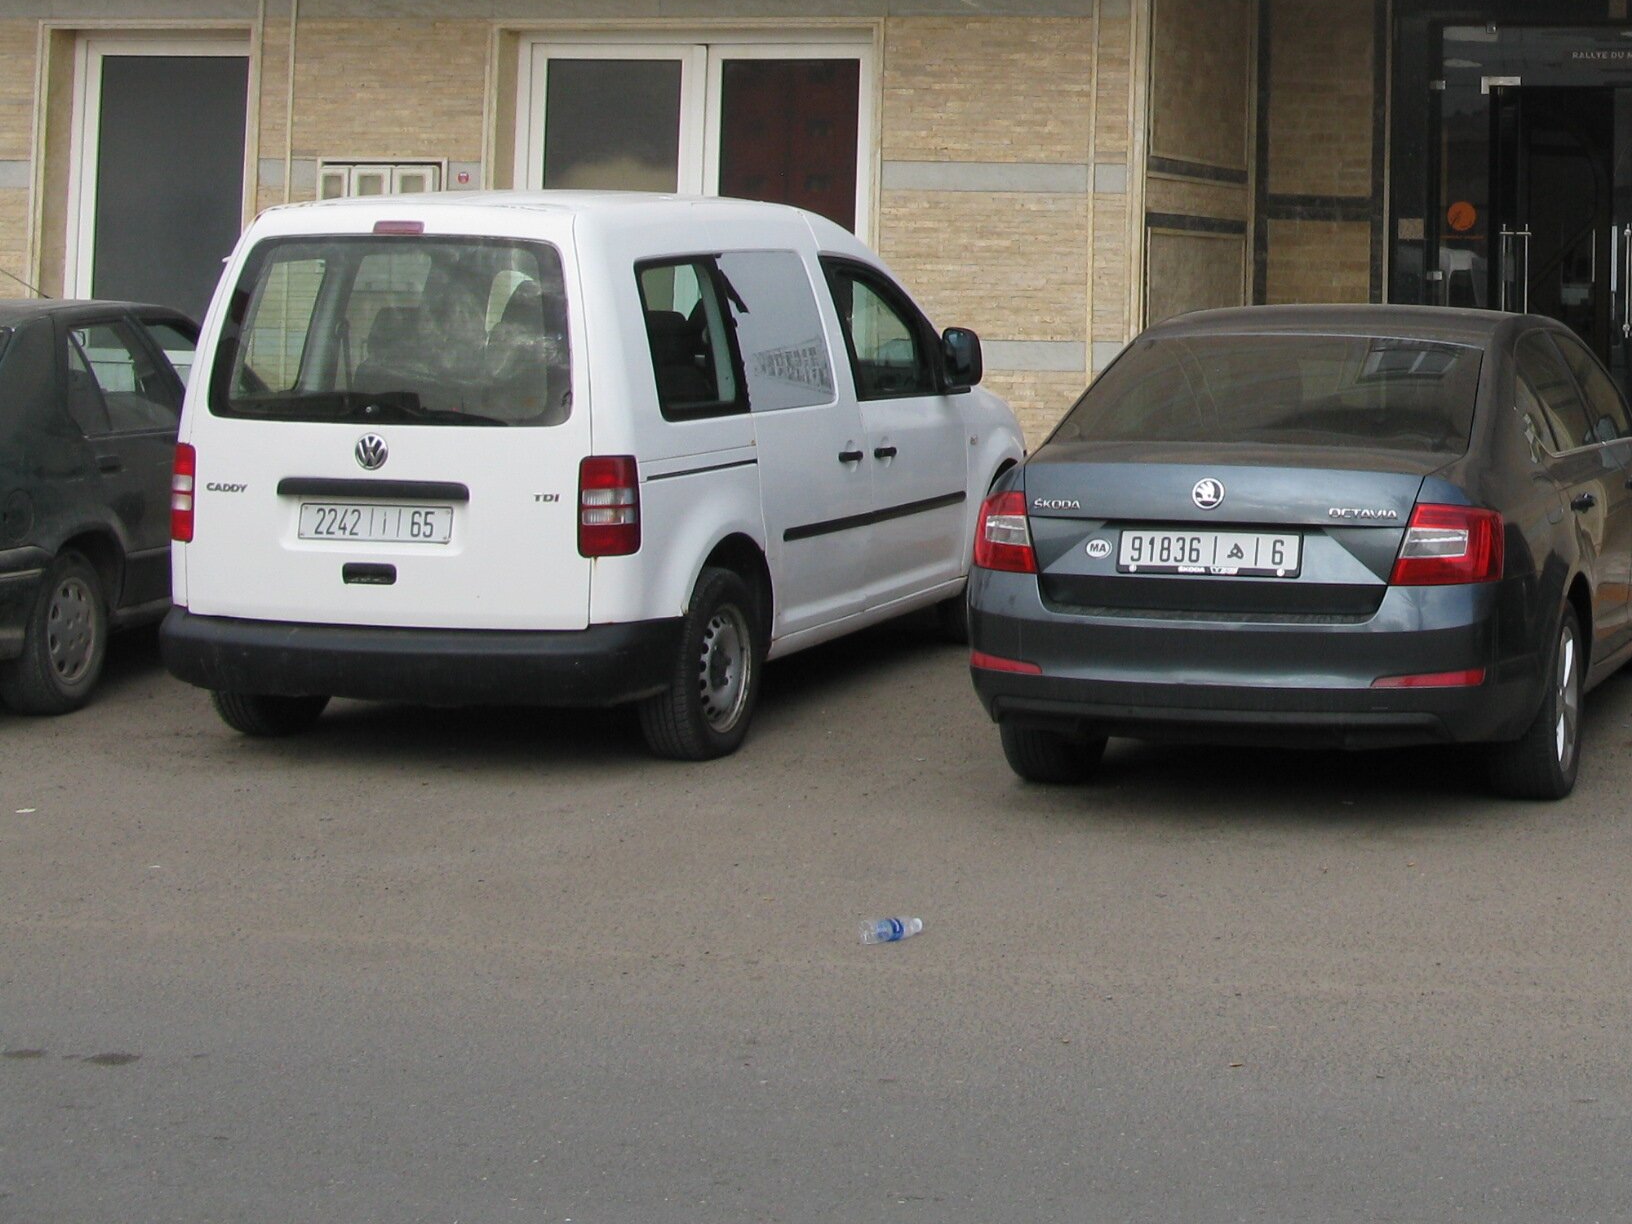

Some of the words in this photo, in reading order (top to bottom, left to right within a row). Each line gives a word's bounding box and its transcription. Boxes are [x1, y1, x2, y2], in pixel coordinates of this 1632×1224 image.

[1572, 51, 1608, 60] RALLYE
[1610, 51, 1625, 60] DU
[206, 482, 248, 493] CADDY
[533, 493, 560, 503] TDI
[1328, 507, 1398, 520] OCTAVIA
[314, 508, 361, 536] 2242
[410, 510, 435, 538] 65
[1089, 543, 1107, 553] MA
[1130, 536, 1202, 564] 91836
[1271, 539, 1285, 566] 6
